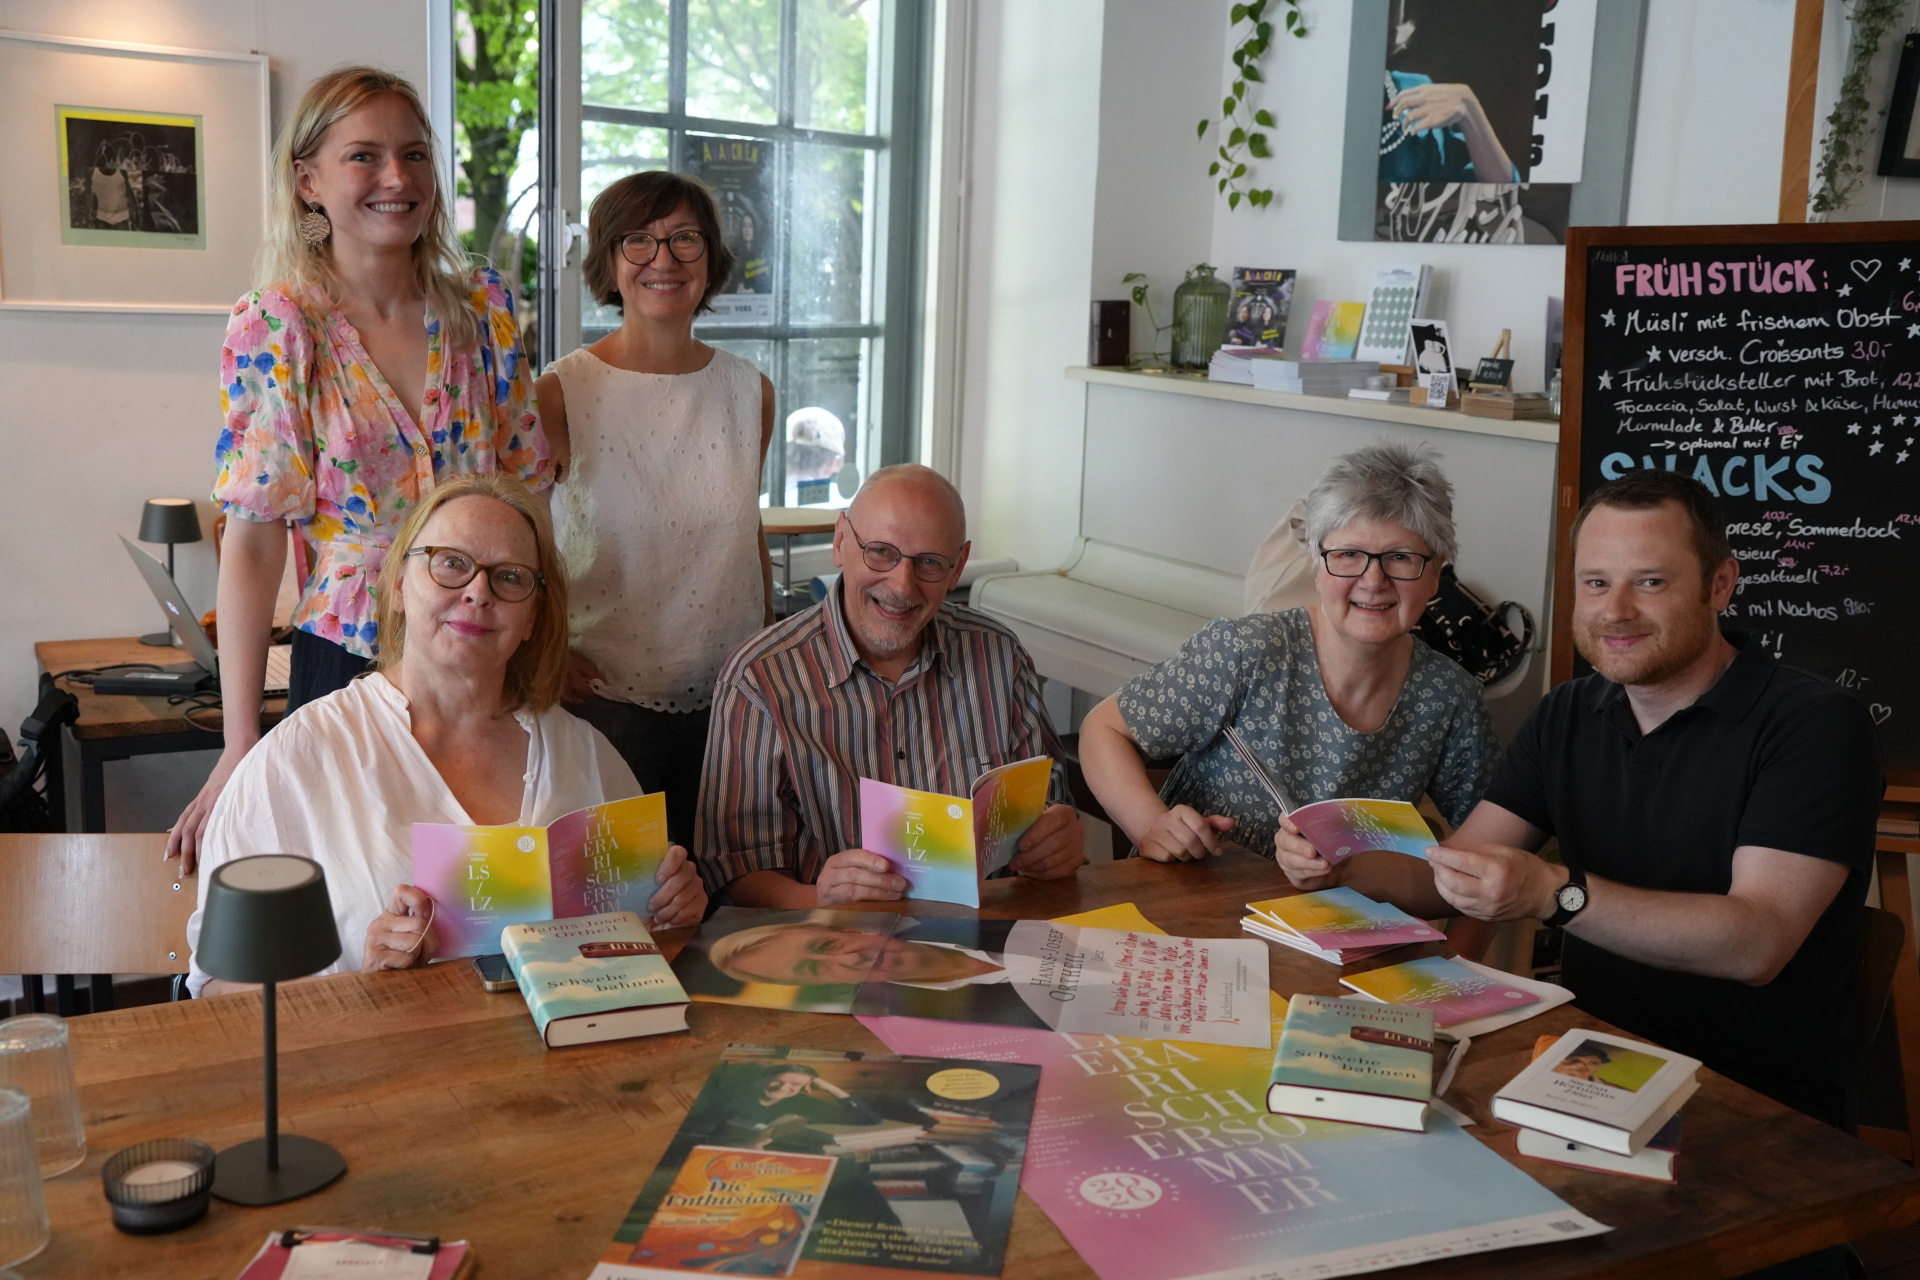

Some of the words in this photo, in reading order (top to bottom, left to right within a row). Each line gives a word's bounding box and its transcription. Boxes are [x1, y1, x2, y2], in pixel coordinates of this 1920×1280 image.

[1624, 309, 1689, 336] Müsli
[1697, 315, 1727, 331] mit
[1736, 309, 1830, 332] frischem
[1837, 307, 1902, 330] Obst
[1669, 349, 1733, 362] versch.
[1739, 338, 1845, 365] Croissants
[1618, 367, 1796, 393] Frühstücksteller
[1804, 373, 1835, 389] mit
[1838, 369, 1885, 390] Brot,
[1613, 400, 1694, 416] Focaccia,
[1695, 398, 1751, 416] Salat,
[1754, 399, 1798, 413] Wurst
[1617, 417, 1704, 434] Marmelade
[1712, 419, 1725, 433] &
[1729, 416, 1777, 434] Butter
[1679, 437, 1738, 456] optional
[1743, 438, 1771, 450] mit
[1780, 435, 1803, 450] Ei
[1787, 517, 1902, 539] Sommerbock
[1749, 600, 1773, 617] mit
[1778, 600, 1839, 620] Nachos
[585, 820, 614, 841] LIT
[906, 821, 924, 836] LS
[583, 836, 620, 858] ERA
[907, 848, 926, 862] LZ
[592, 853, 612, 870] RI
[467, 865, 490, 880] LS
[586, 866, 621, 889] SCH
[470, 896, 493, 911] LZ
[582, 881, 628, 907] ERSO
[523, 915, 630, 935] Hanns-Josef
[555, 924, 618, 939] Ortheil
[547, 972, 628, 989] Schwebe
[596, 977, 665, 992] bahnen
[1048, 953, 1085, 1002] ORTHEIL
[1336, 1009, 1404, 1025] Ortheil
[1064, 1042, 1208, 1077] ERA
[1294, 1049, 1382, 1066] Schwebe
[1342, 1062, 1417, 1080] bahnen
[1119, 1067, 1204, 1098] RI
[1122, 1088, 1265, 1130] SCH
[1124, 1113, 1308, 1161] ERSO
[1185, 1142, 1321, 1184] MM
[707, 1180, 748, 1193] Die
[1230, 1175, 1345, 1215] ER
[665, 1191, 813, 1208] Enthusiasten
